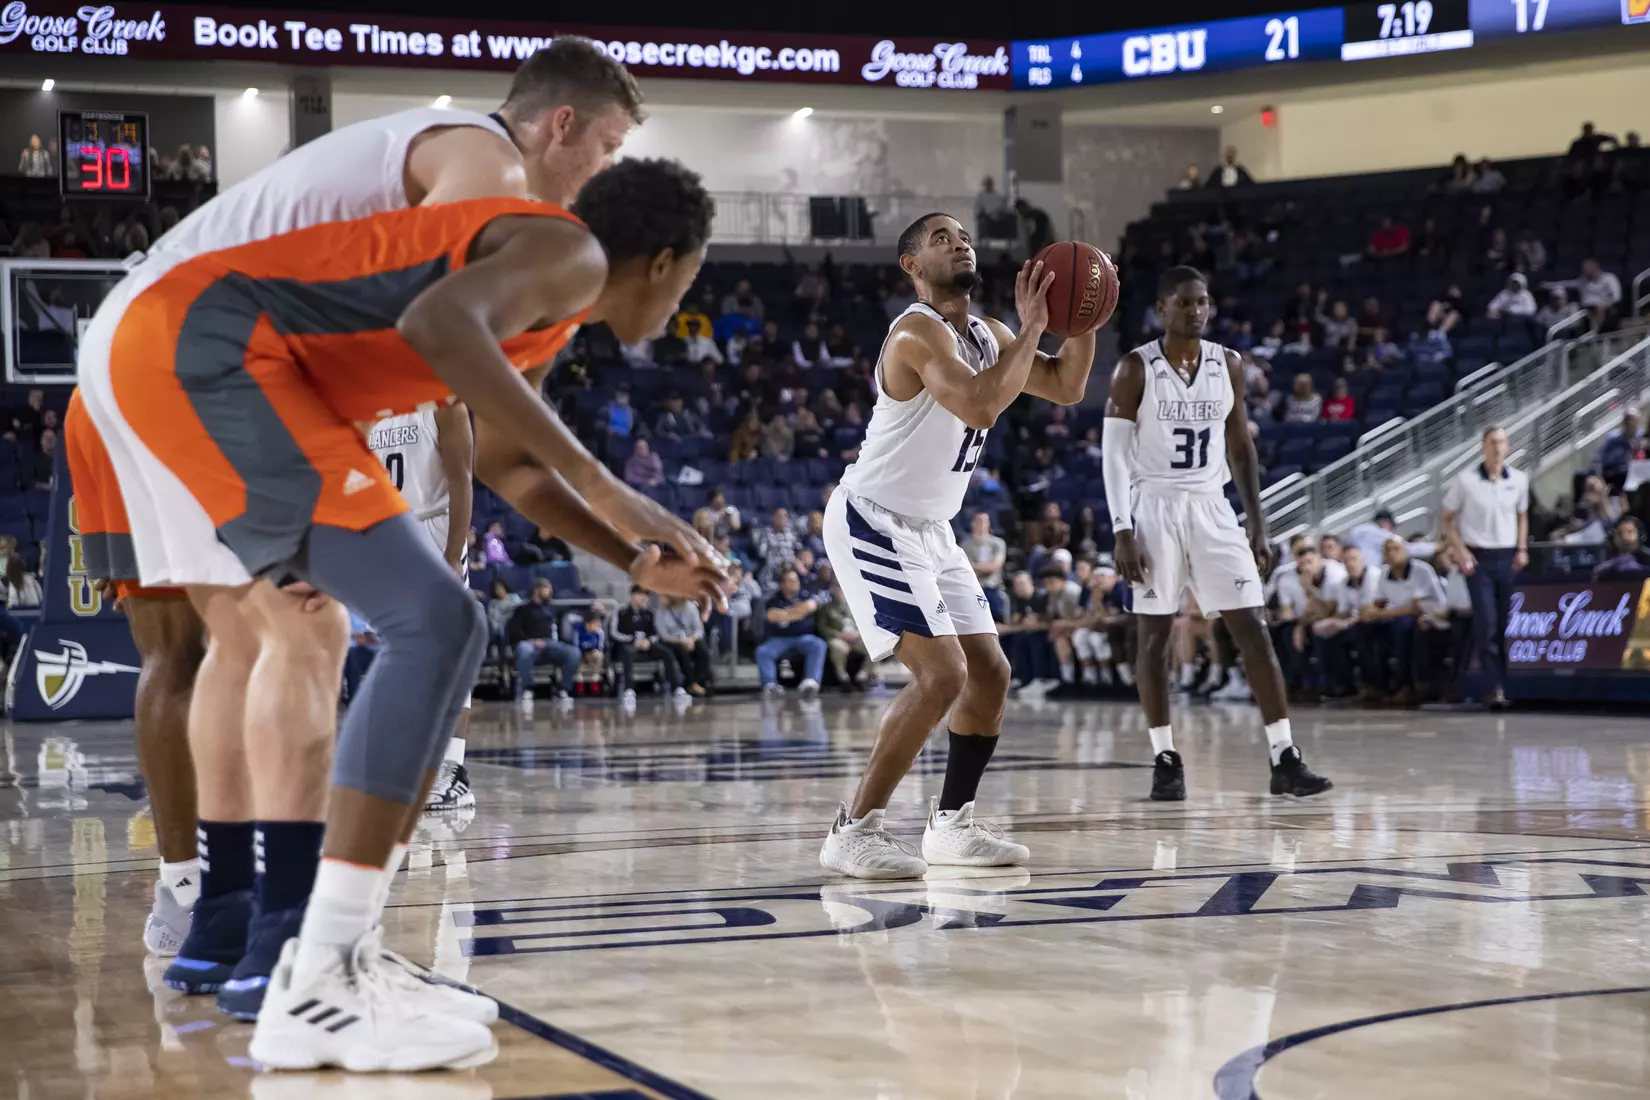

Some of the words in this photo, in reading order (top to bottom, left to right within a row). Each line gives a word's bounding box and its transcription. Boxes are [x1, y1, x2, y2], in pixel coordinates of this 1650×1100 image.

[0, 1, 78, 44] Goose
[77, 6, 166, 41] Creek
[1377, 0, 1433, 38] 7:19
[1511, 0, 1549, 32] 17
[31, 34, 78, 52] GOLF
[81, 37, 128, 55] CLUB
[194, 16, 278, 48] Book
[284, 21, 343, 51] Tee
[349, 24, 444, 56] Times
[452, 30, 481, 57] at
[487, 35, 840, 75] wwoosecreekgc.com
[1122, 28, 1208, 77] CBU
[1264, 16, 1299, 61] 21
[861, 40, 937, 81] Goose
[896, 70, 937, 88] GOLF
[936, 71, 978, 89] CLUB
[81, 146, 130, 190] 30
[1077, 256, 1102, 318] Wilson
[1158, 400, 1223, 421] LANCERS
[369, 425, 418, 450] LANCERS
[1170, 427, 1211, 469] 31
[1509, 640, 1549, 662] GOLF
[1546, 640, 1588, 662] CLUB
